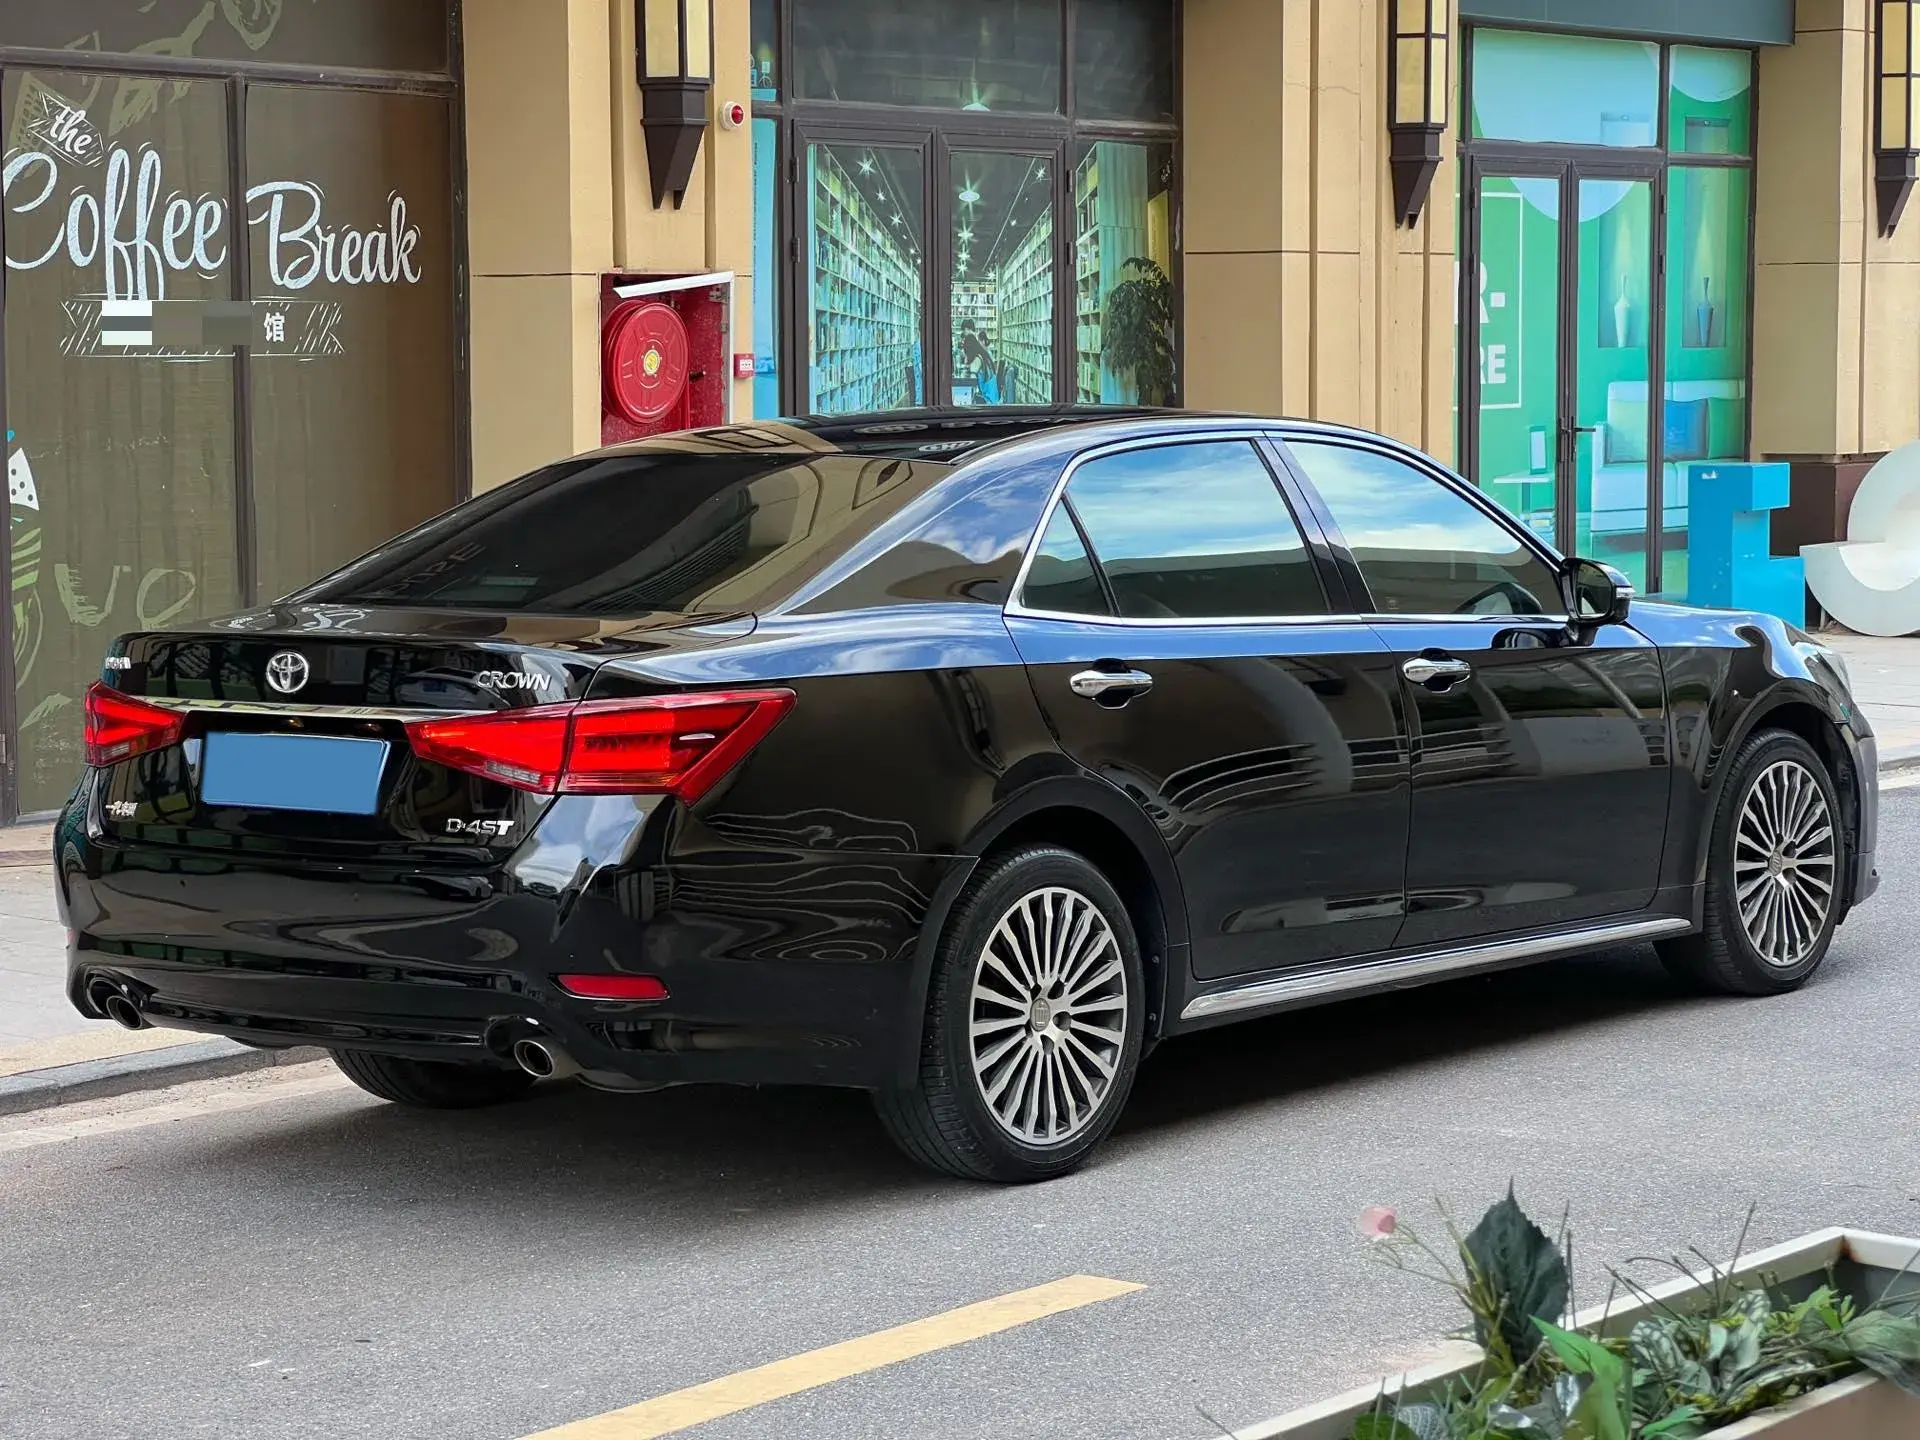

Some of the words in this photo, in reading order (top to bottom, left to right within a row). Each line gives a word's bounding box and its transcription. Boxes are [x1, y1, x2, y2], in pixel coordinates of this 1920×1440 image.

[49, 106, 93, 155] the
[2, 148, 227, 302] Coffee
[245, 181, 422, 290] Break
[477, 670, 552, 691] CROWN
